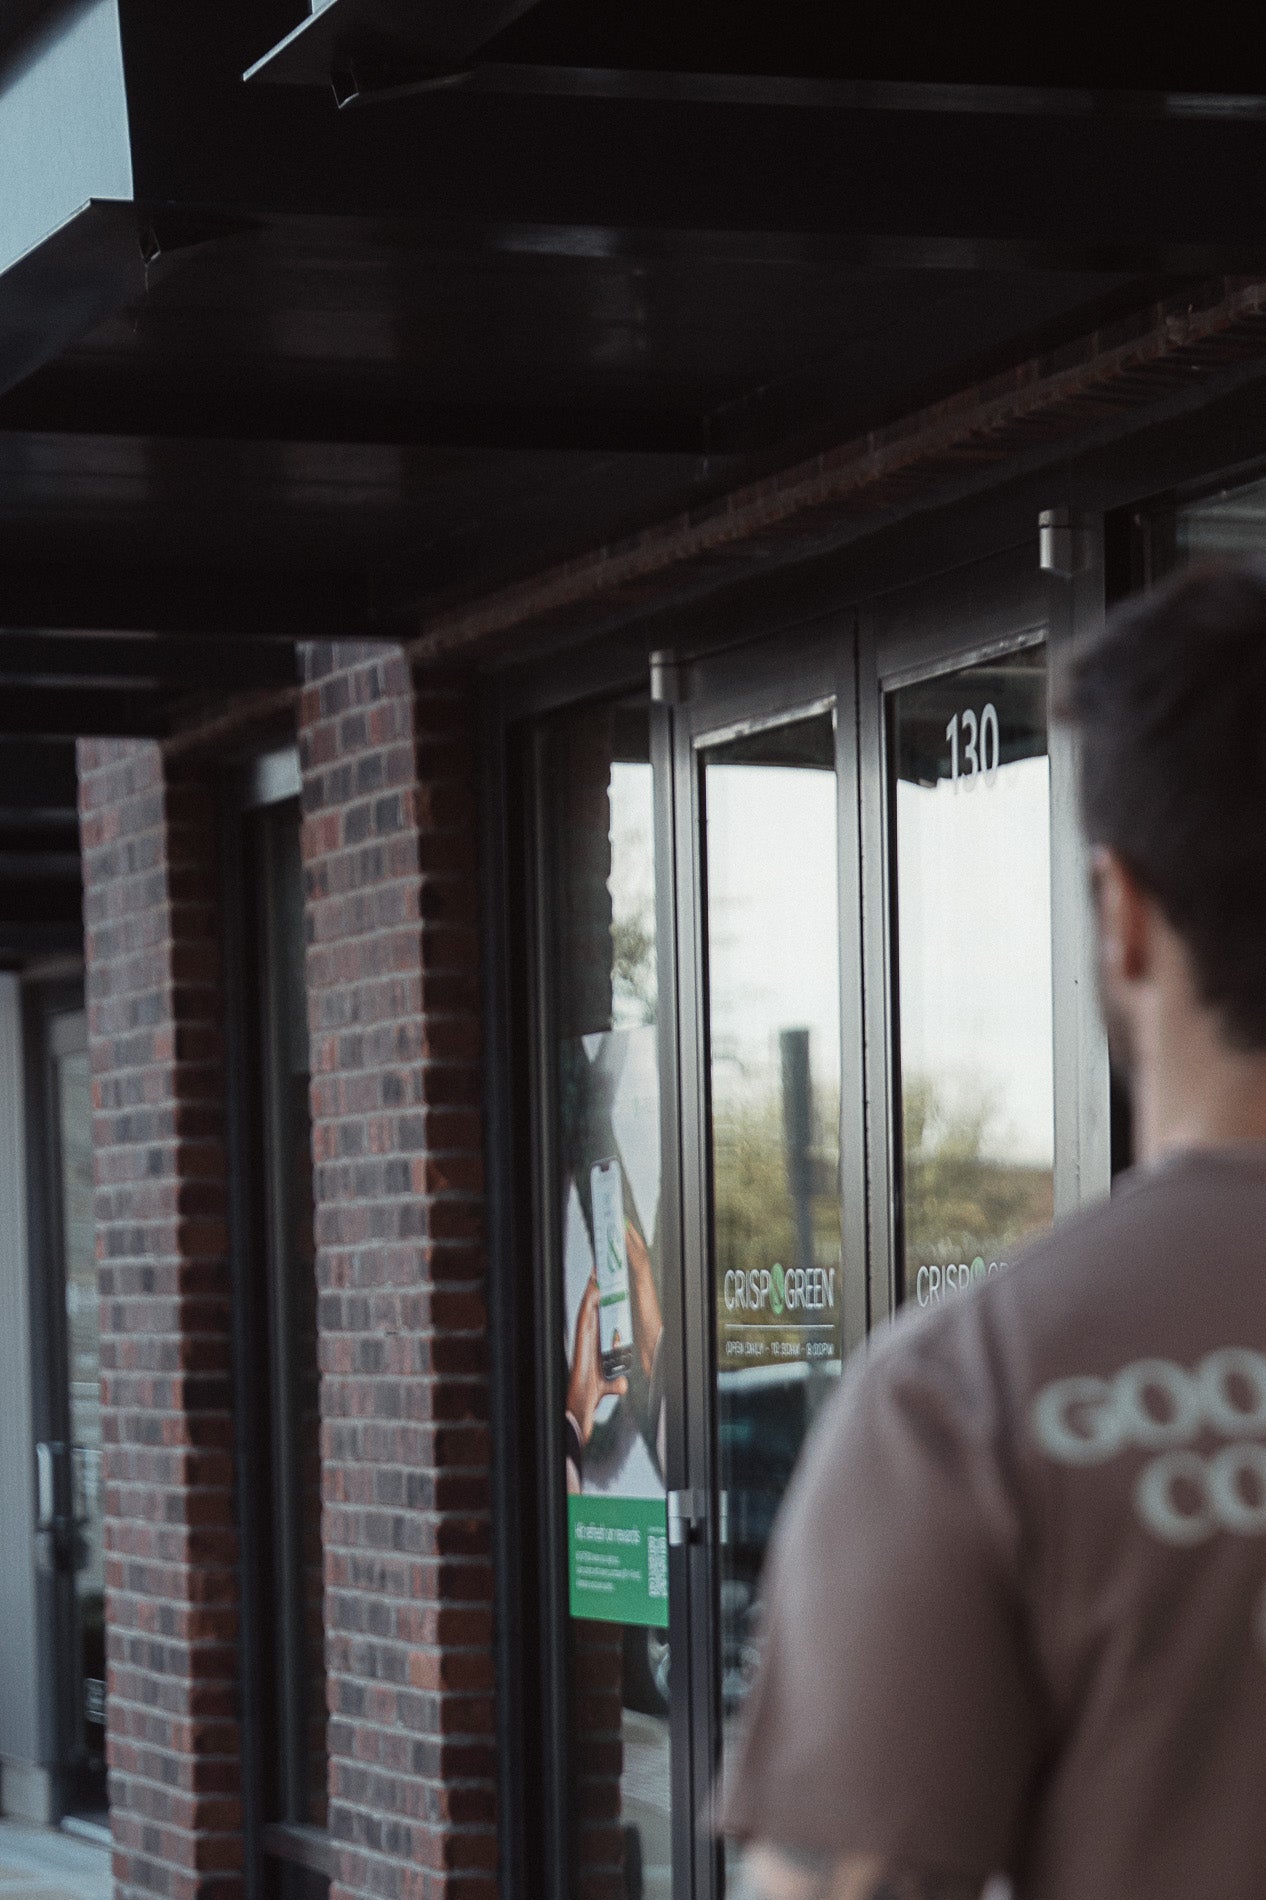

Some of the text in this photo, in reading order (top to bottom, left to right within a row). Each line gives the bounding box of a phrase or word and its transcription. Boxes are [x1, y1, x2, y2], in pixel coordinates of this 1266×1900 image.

[944, 702, 1000, 796] 130
[724, 1268, 770, 1311] CRISP
[784, 1267, 836, 1310] GREEN
